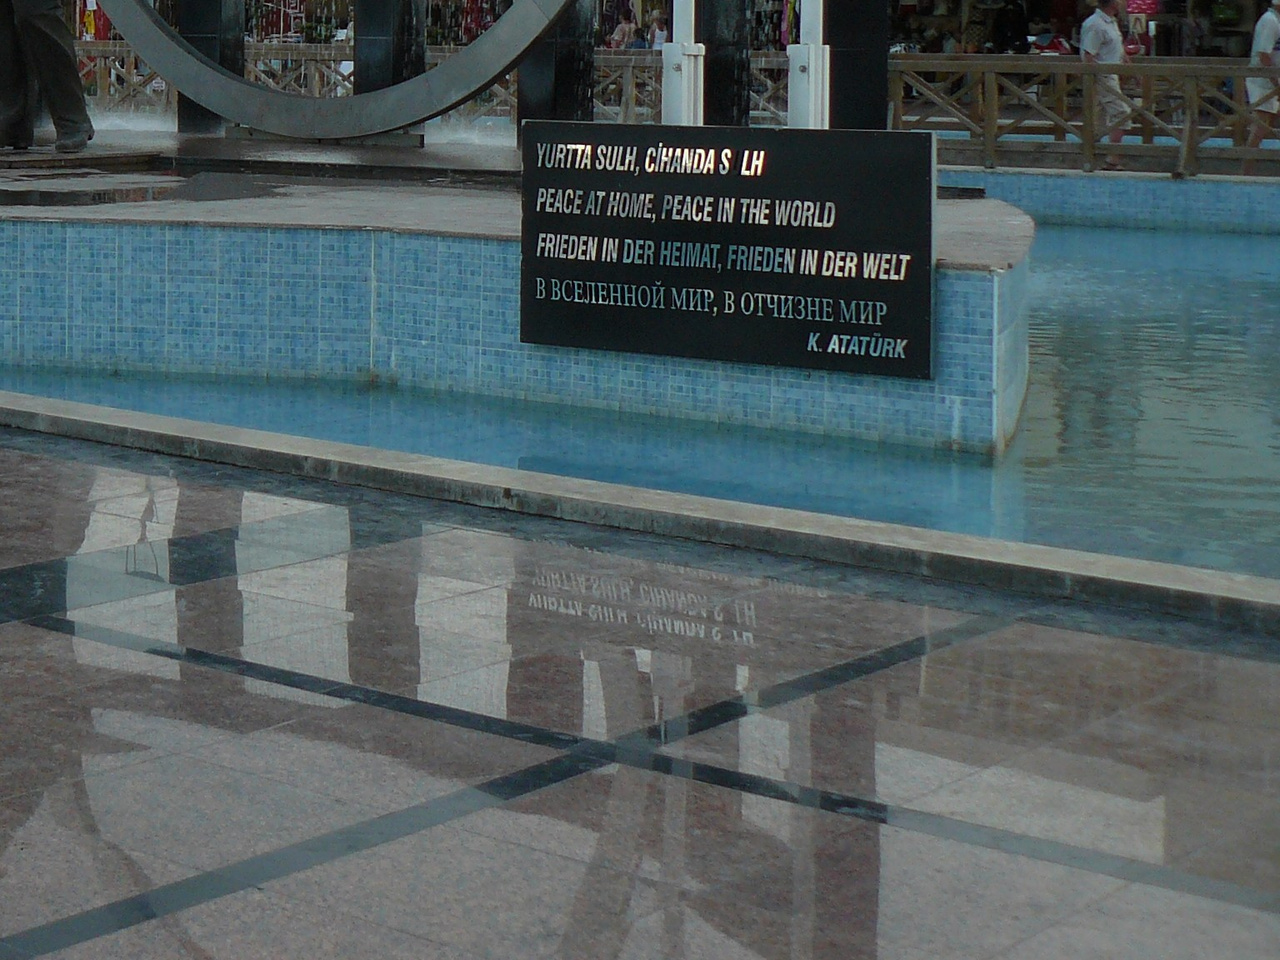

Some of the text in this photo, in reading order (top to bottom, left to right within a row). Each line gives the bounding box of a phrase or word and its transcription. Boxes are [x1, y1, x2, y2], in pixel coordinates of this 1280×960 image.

[536, 142, 592, 170] YURTTA
[595, 144, 640, 176] SULH,
[536, 187, 836, 228] PEACE AT HOME, PEACE IN THE WORLD
[536, 232, 911, 281] FRIEDEN IN DER HEIMAT, FRIEDEN IN DER WELT
[535, 277, 887, 326] В ВСЕЛЕННОЙ МИР, В ОТЧИЗНЕ МИР
[807, 332, 908, 359] K. ATATÜRK
